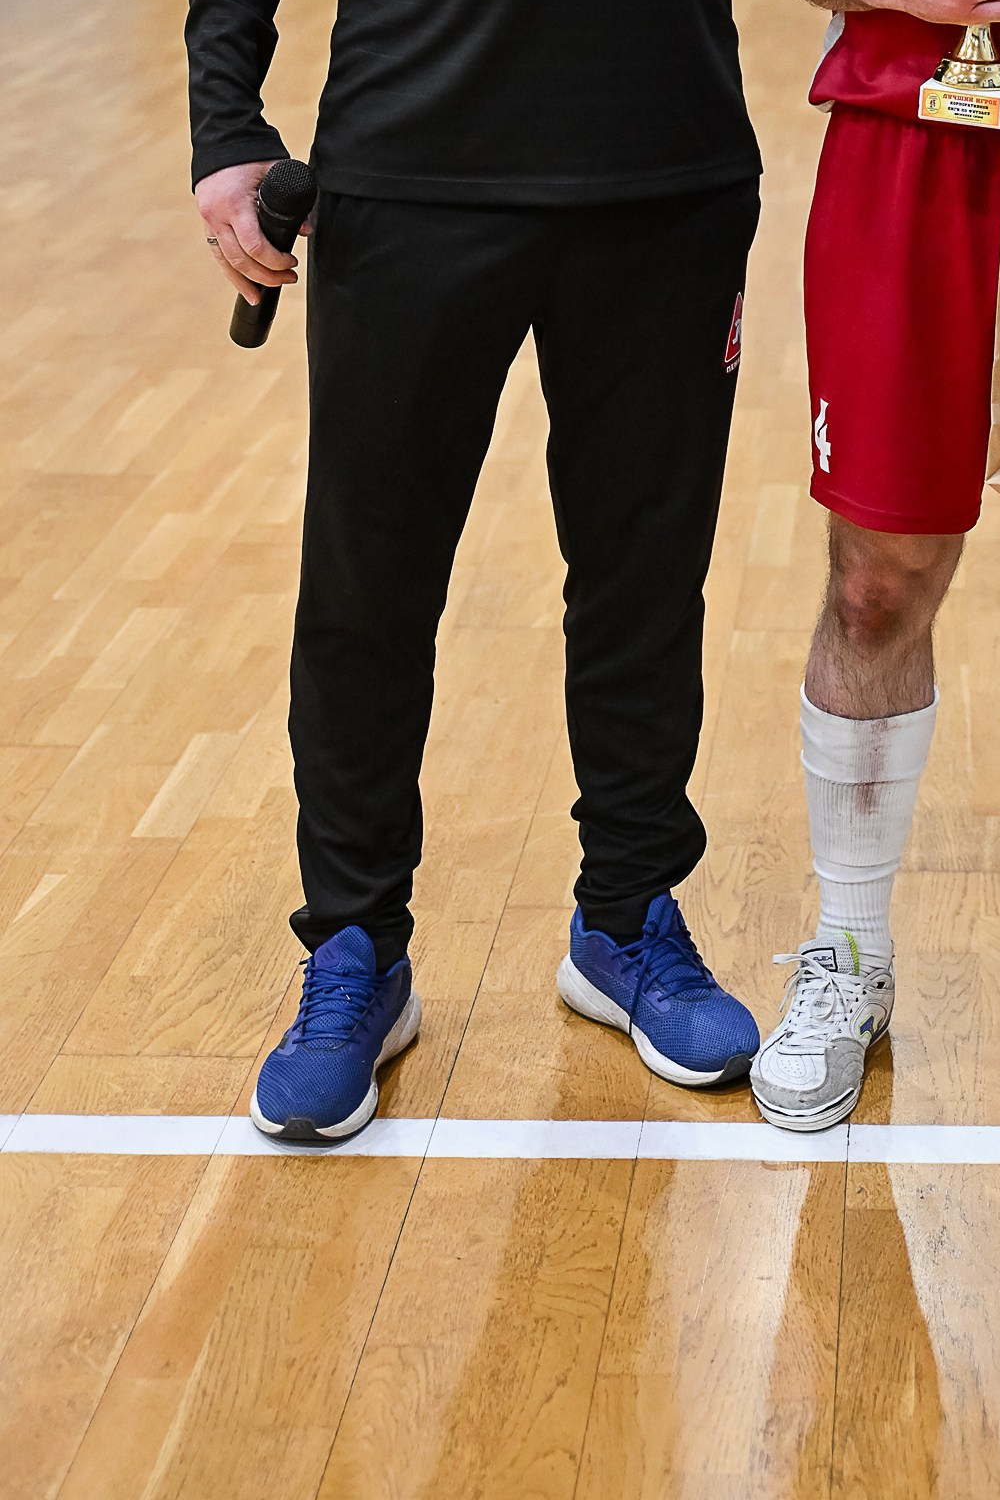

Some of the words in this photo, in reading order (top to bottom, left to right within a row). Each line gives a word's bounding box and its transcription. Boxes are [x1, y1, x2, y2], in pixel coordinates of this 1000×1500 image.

[943, 93, 974, 102] ЛУЧШИЙ
[975, 98, 998, 106] ИГРОК
[814, 398, 831, 474] 4
